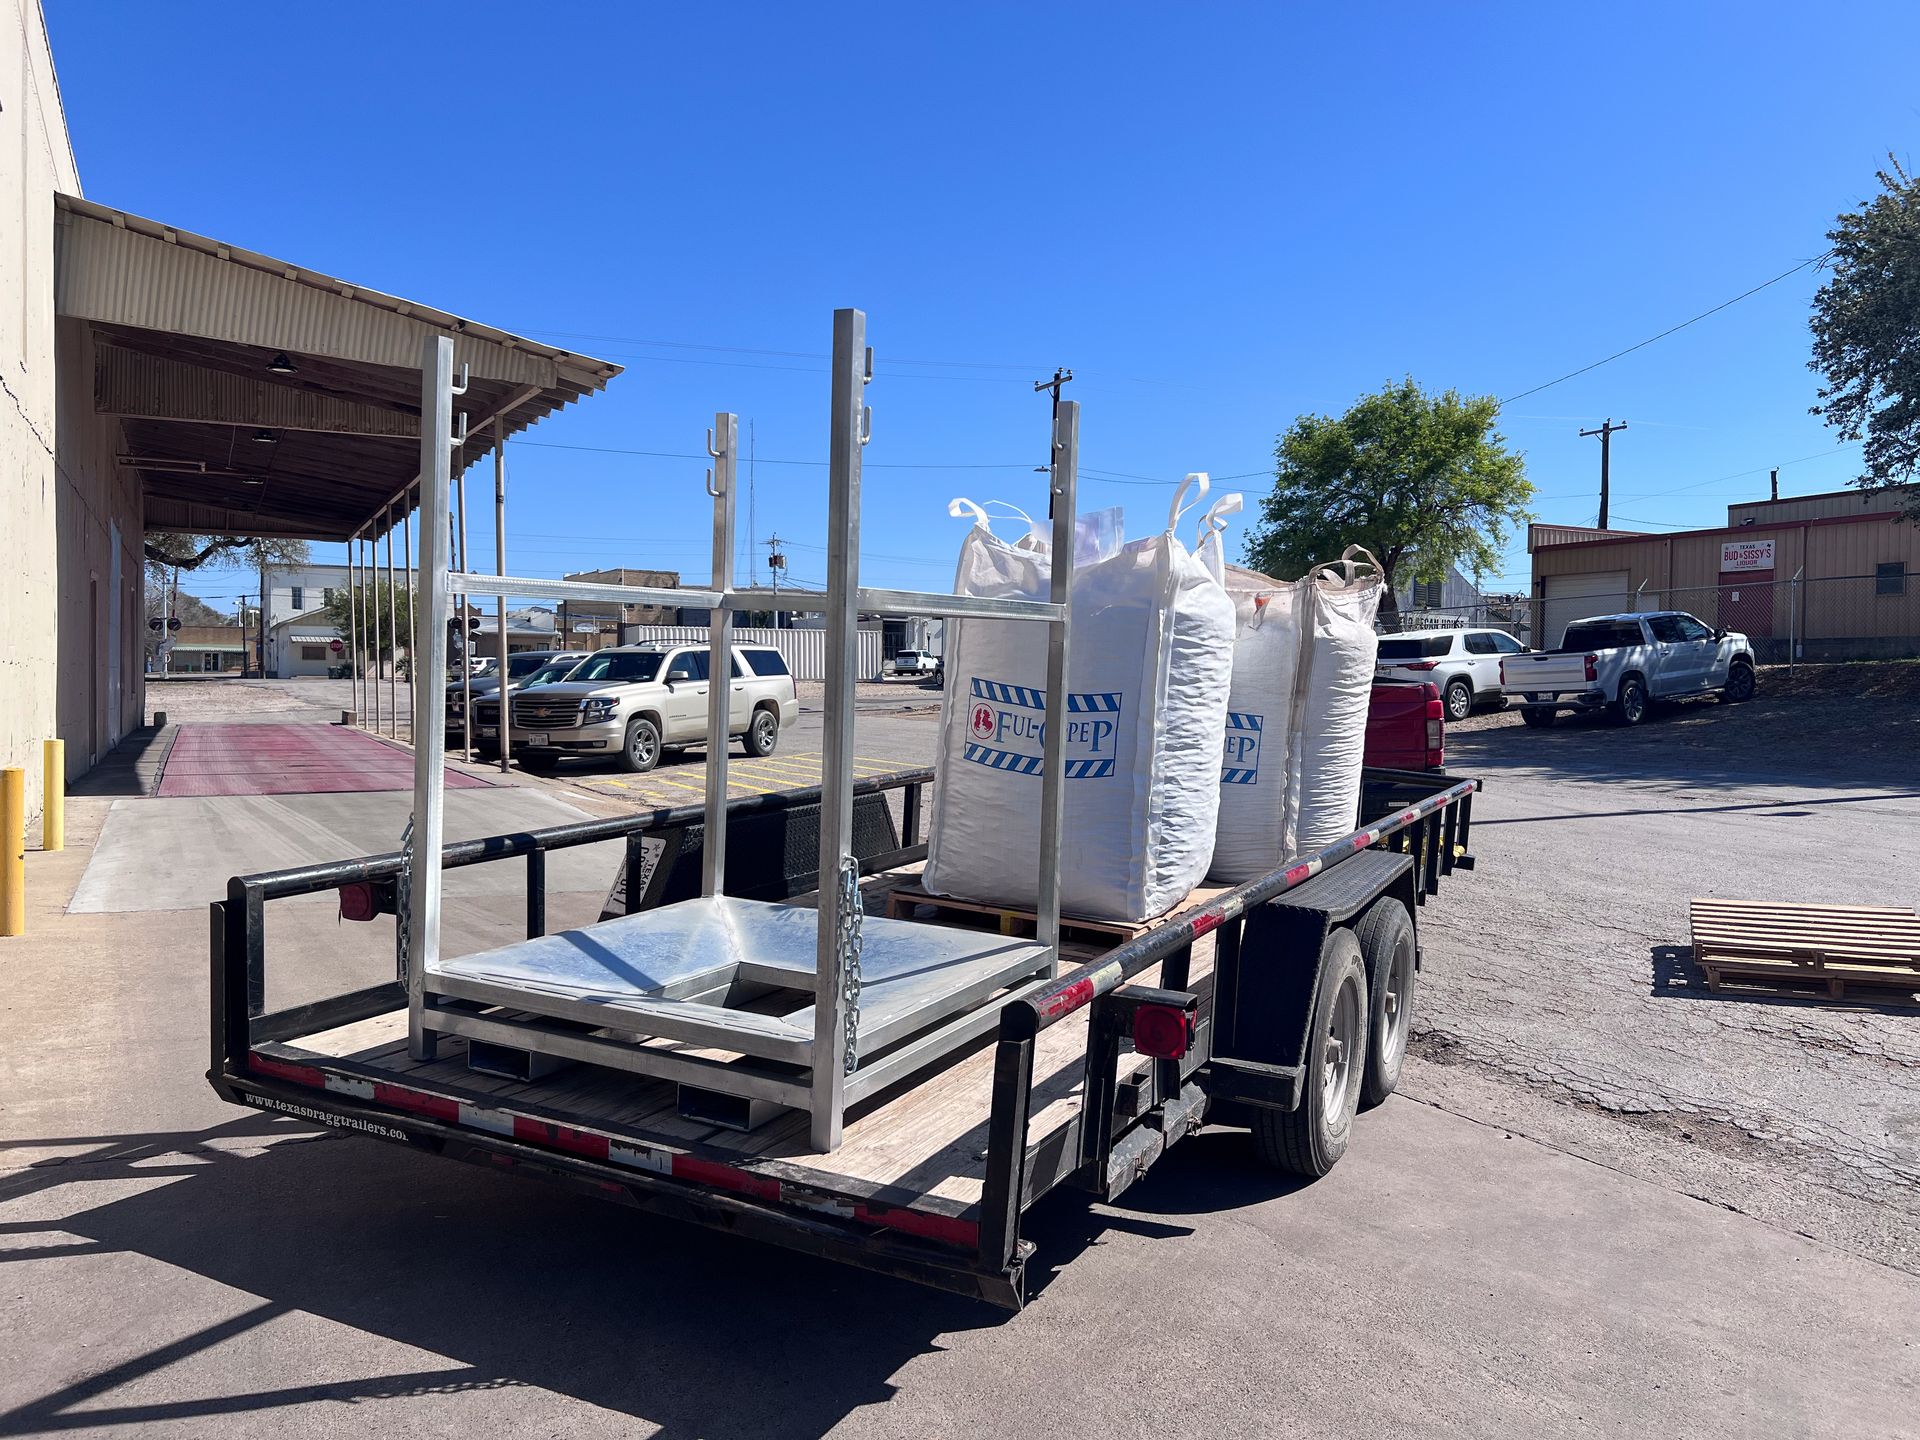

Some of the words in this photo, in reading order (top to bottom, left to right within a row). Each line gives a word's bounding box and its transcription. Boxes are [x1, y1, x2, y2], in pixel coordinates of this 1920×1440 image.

[1724, 551, 1738, 561] BUD
[1743, 549, 1771, 559] SISSY'S
[994, 710, 1113, 752] FUL-PEP
[640, 862, 655, 892] TEXAS
